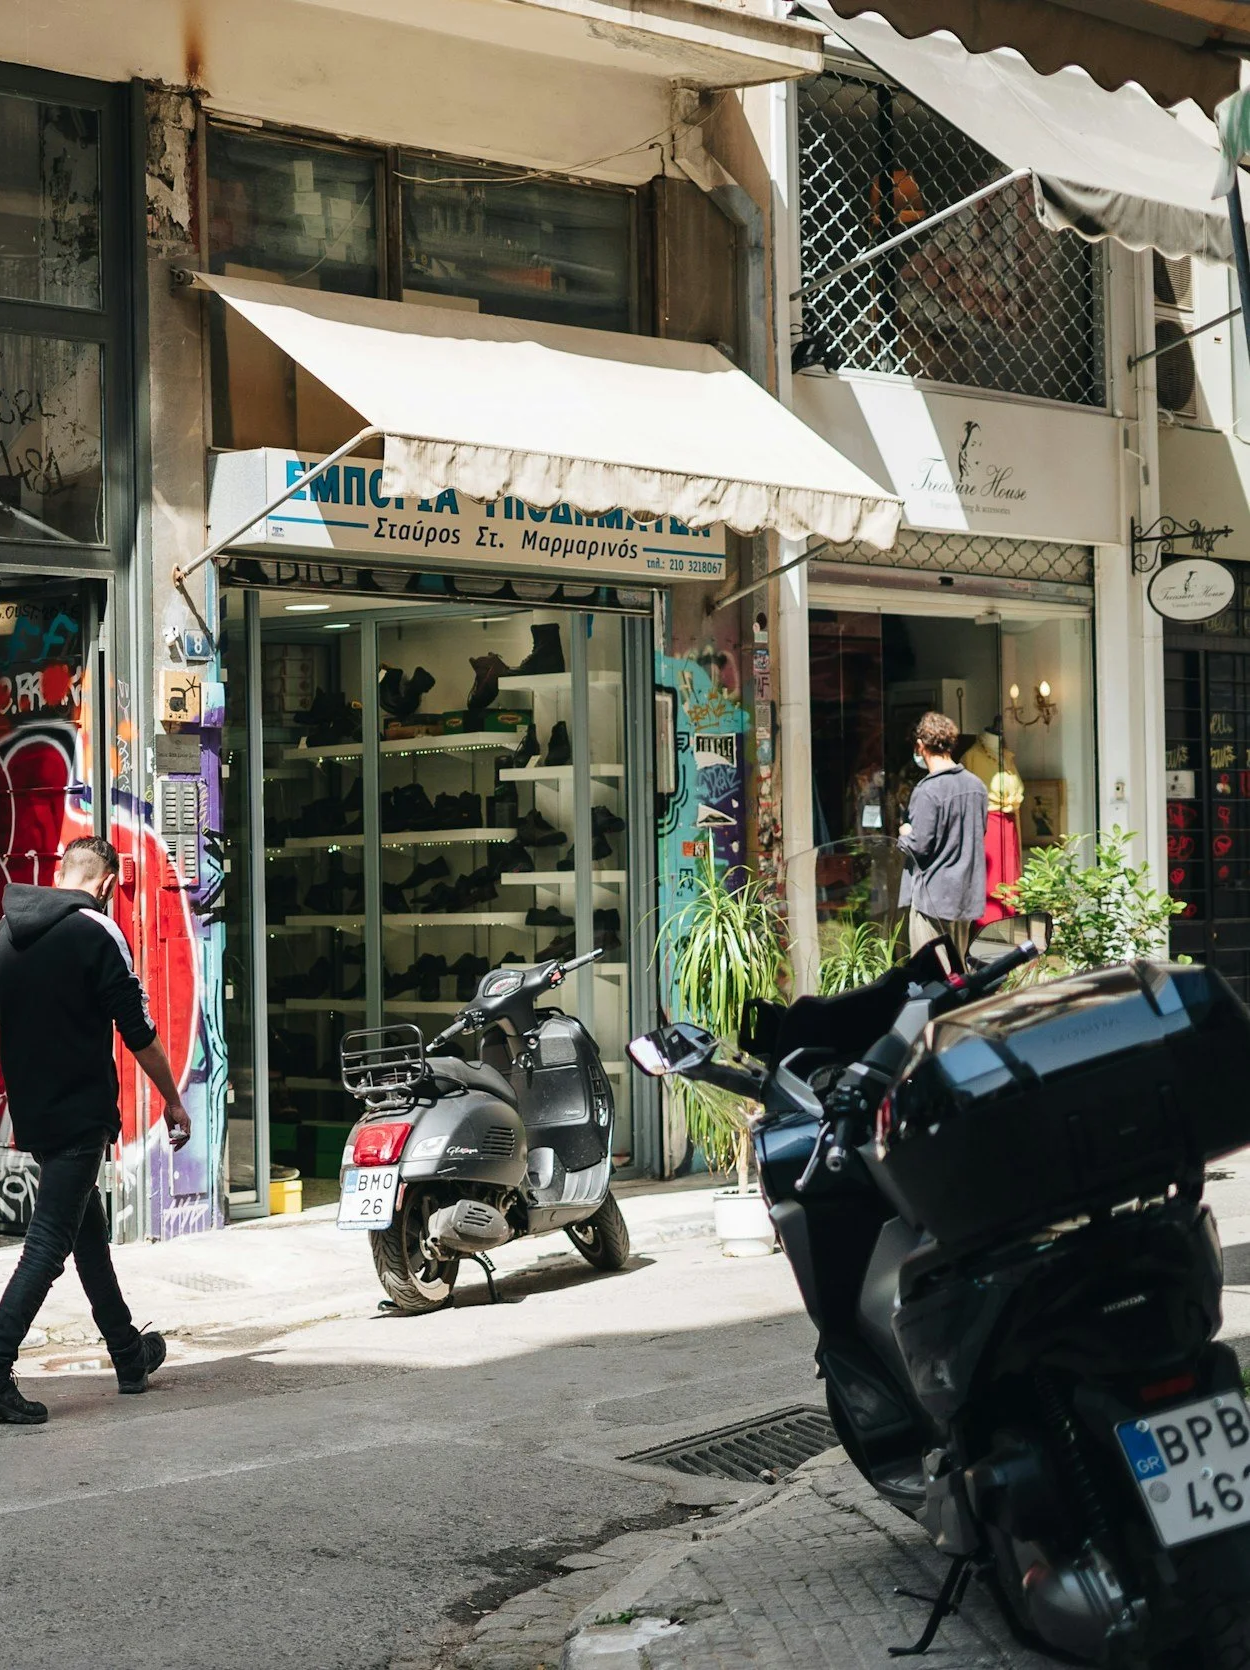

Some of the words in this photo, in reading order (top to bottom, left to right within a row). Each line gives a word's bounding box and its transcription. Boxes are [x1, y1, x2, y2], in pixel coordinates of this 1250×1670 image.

[980, 464, 1027, 501] House
[374, 517, 461, 548] Σταύρος
[475, 526, 504, 549] Στ.
[521, 529, 638, 561] Μαρμαρινός
[669, 558, 684, 572] 210
[688, 560, 723, 574] 3218067
[194, 636, 203, 654] 8
[358, 1173, 393, 1191] BMO
[360, 1198, 383, 1216] 26
[1102, 1294, 1148, 1314] HONDA
[1156, 1406, 1250, 1467] BPB
[1136, 1456, 1163, 1475] GR
[1186, 1464, 1250, 1521] 46
